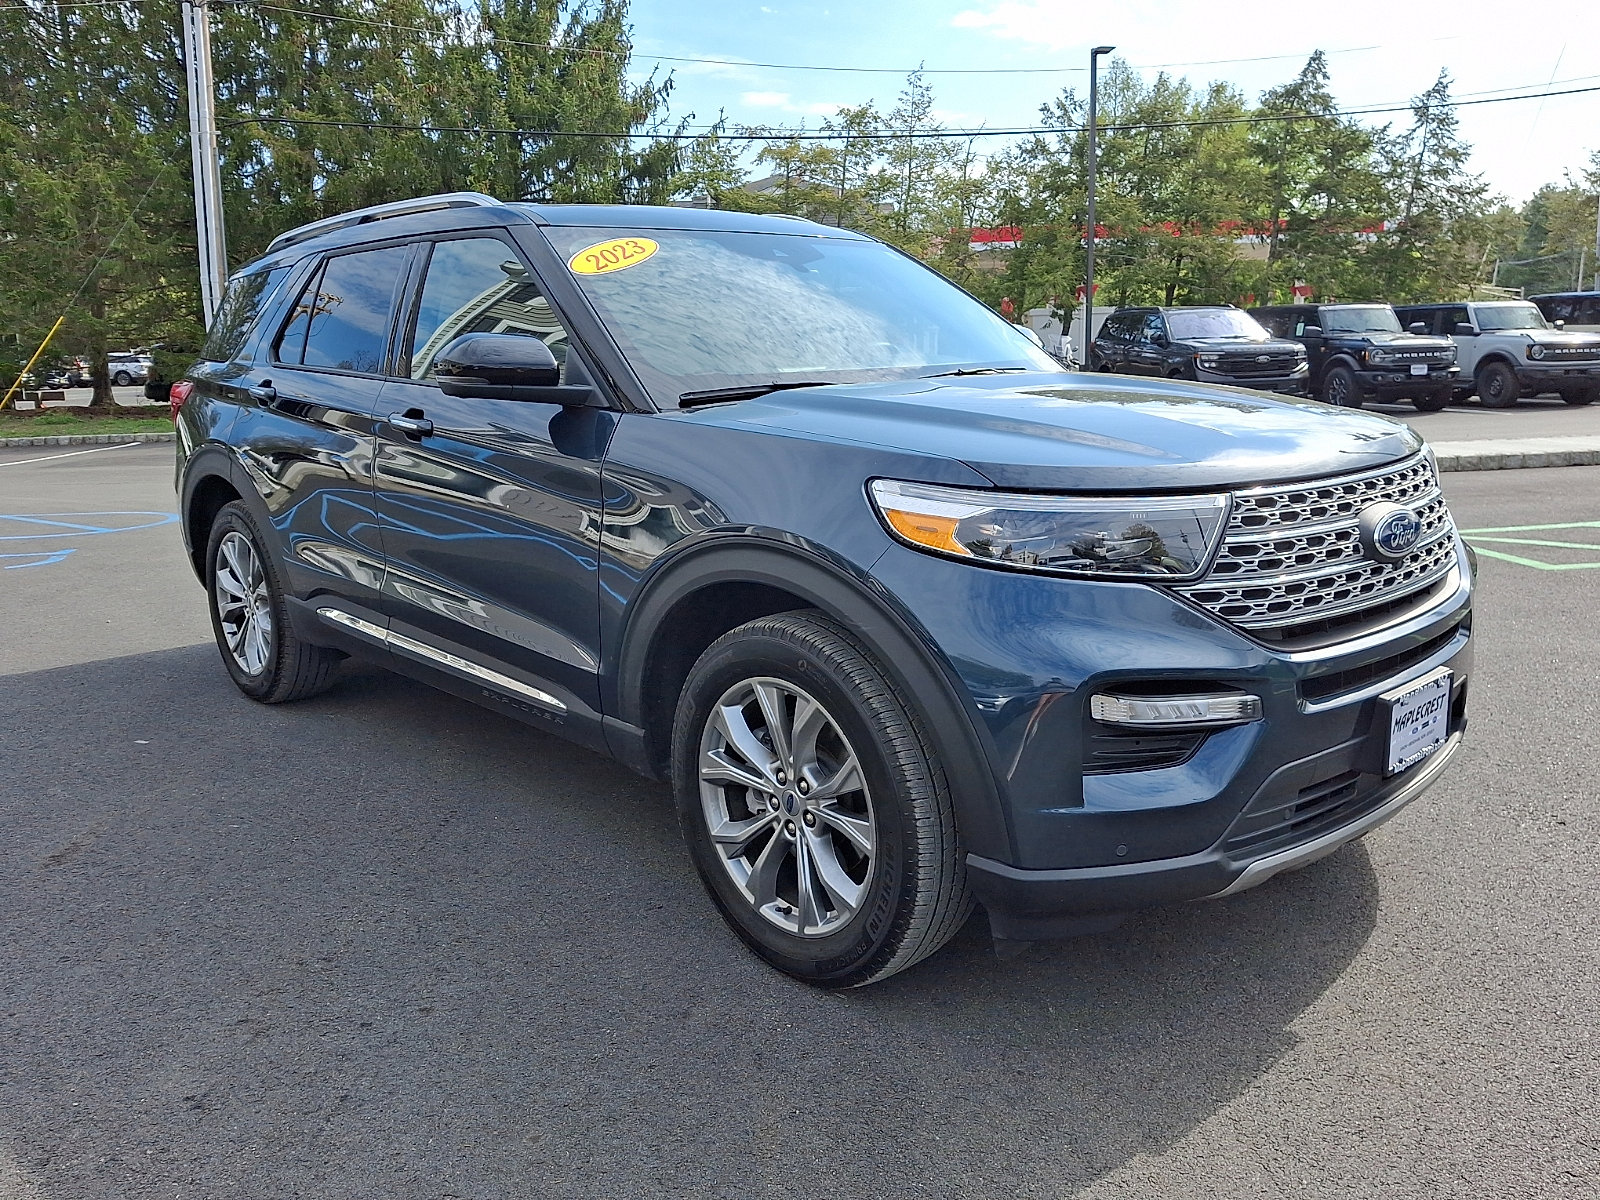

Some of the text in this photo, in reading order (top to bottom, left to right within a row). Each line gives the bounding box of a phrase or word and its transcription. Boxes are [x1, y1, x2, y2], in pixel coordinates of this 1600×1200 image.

[585, 240, 646, 271] 2023
[1390, 518, 1417, 548] Ford
[1392, 692, 1447, 736] MAPLECREST
[868, 841, 898, 935] MICHELIN
